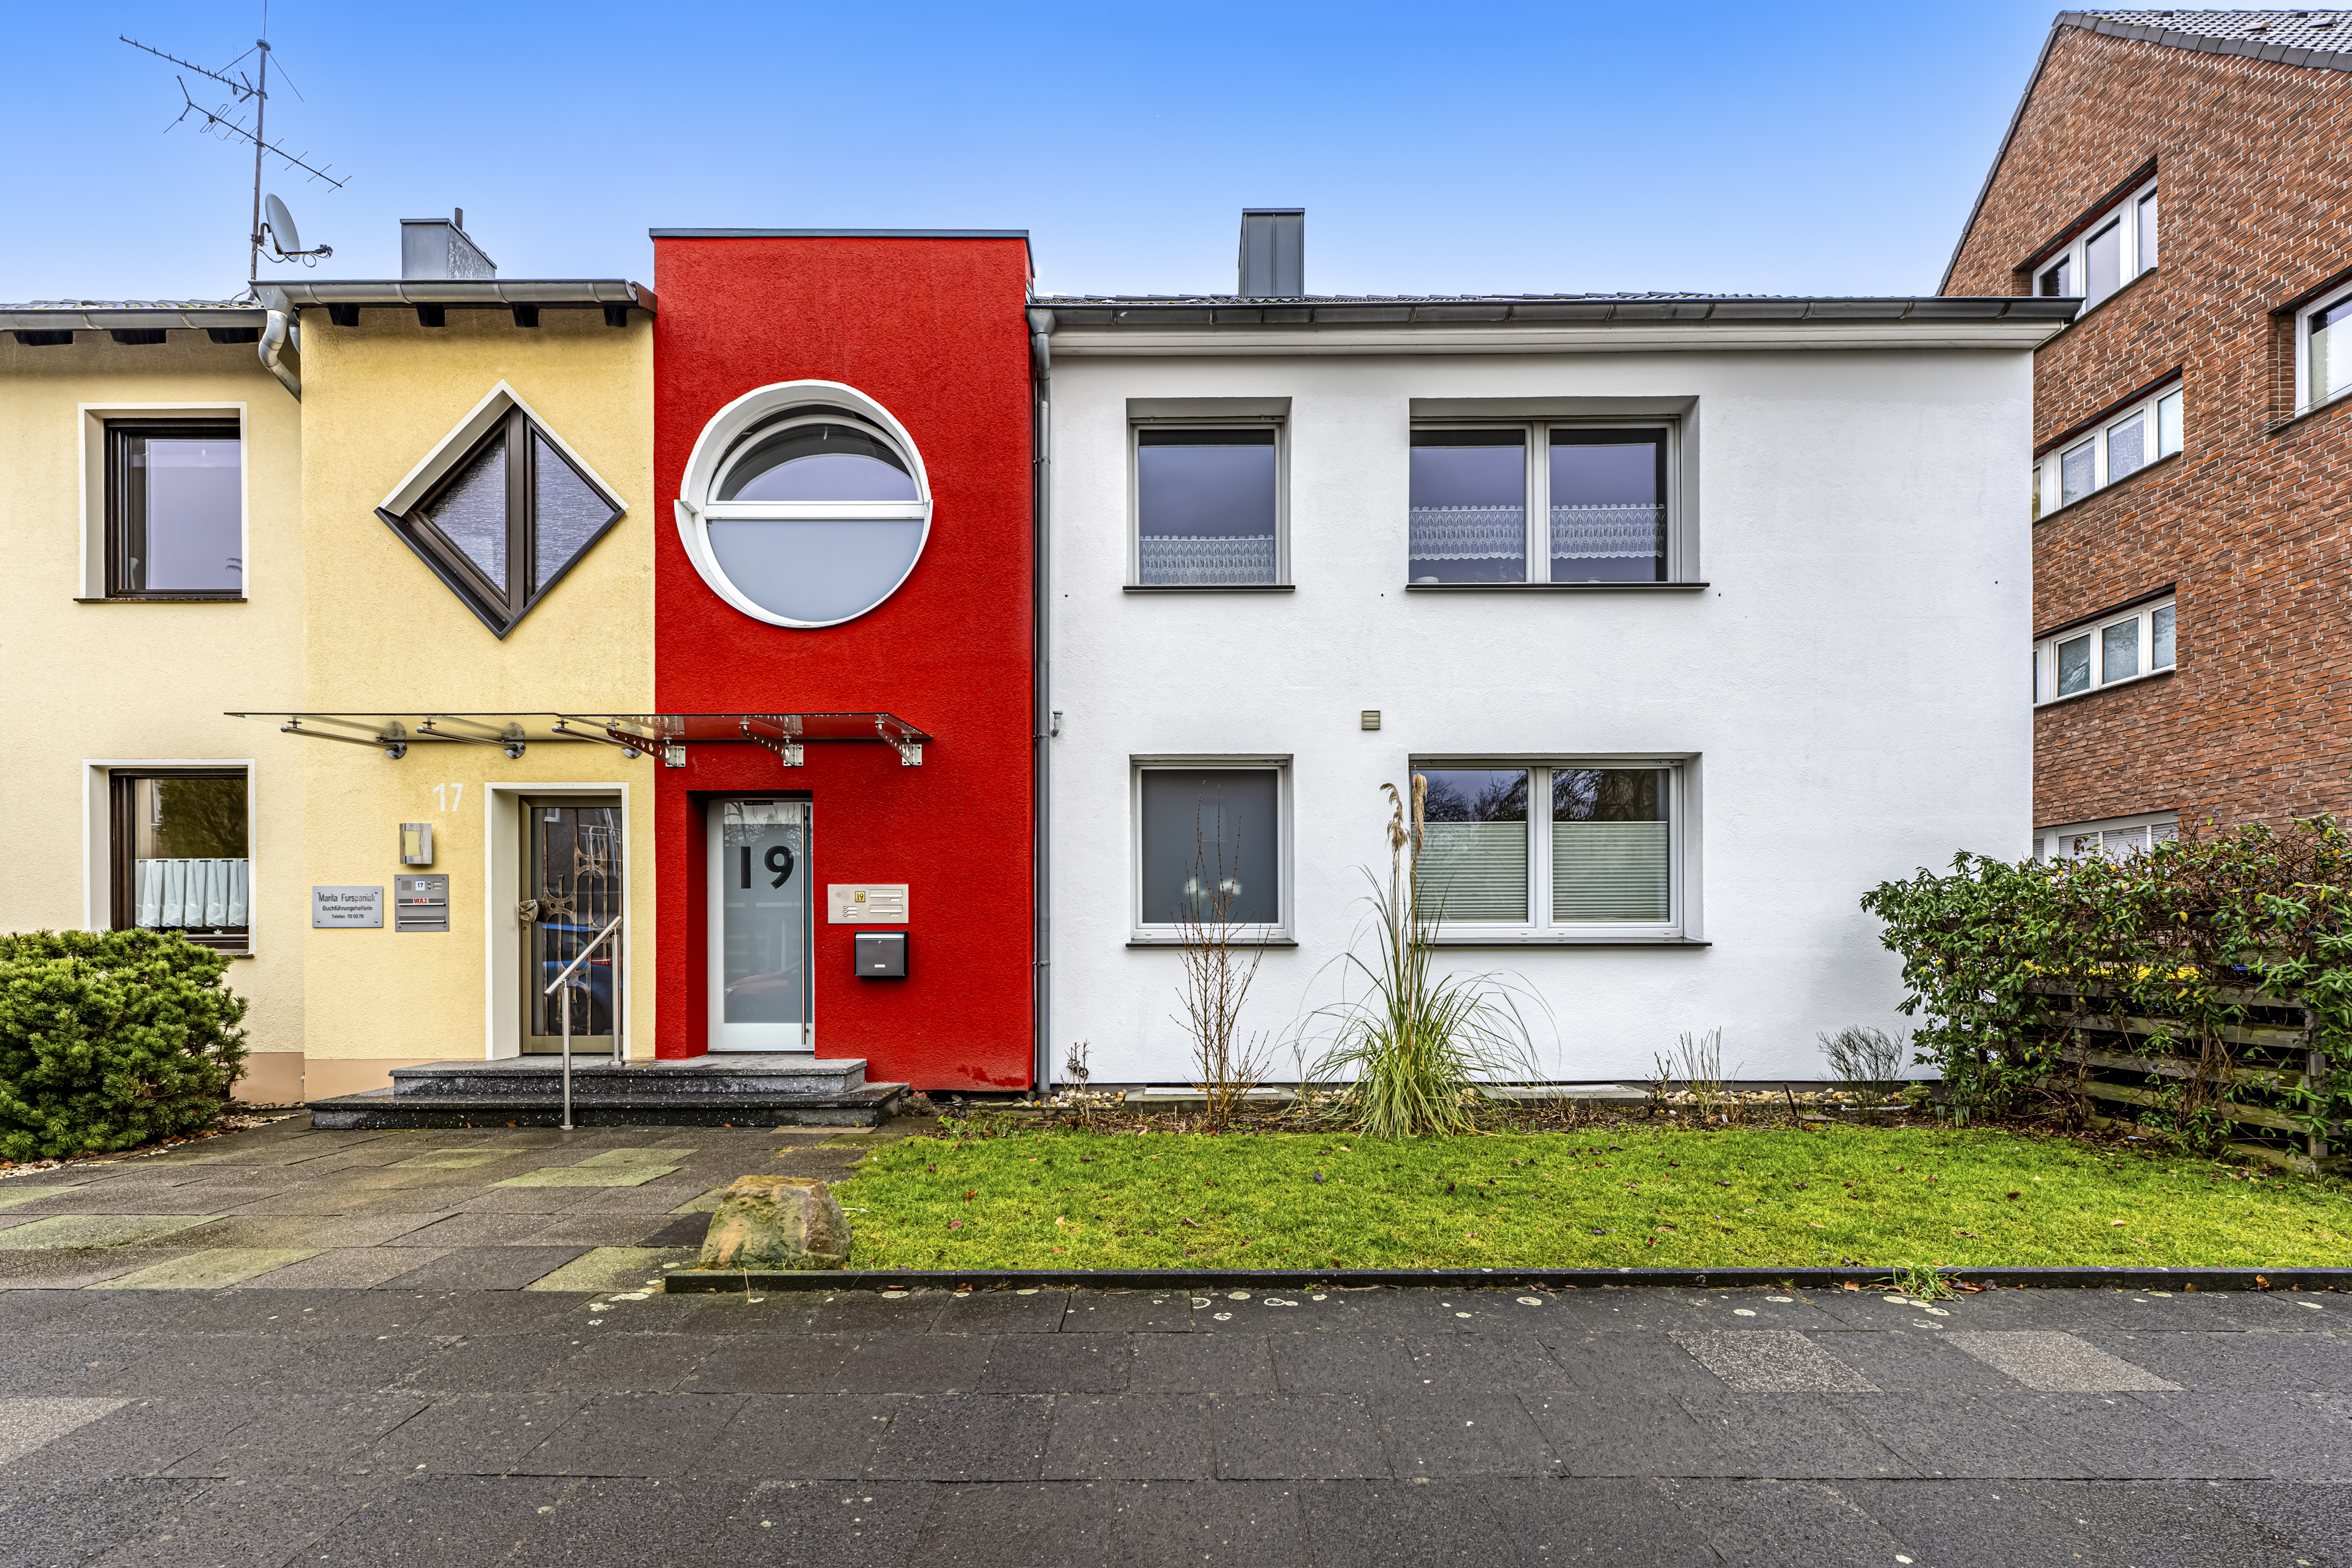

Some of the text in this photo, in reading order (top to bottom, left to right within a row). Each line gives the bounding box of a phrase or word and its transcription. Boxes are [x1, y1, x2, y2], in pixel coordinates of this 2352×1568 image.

[433, 783, 464, 811] 17
[741, 845, 794, 890] 19
[319, 894, 376, 903] Marita Furspaniak
